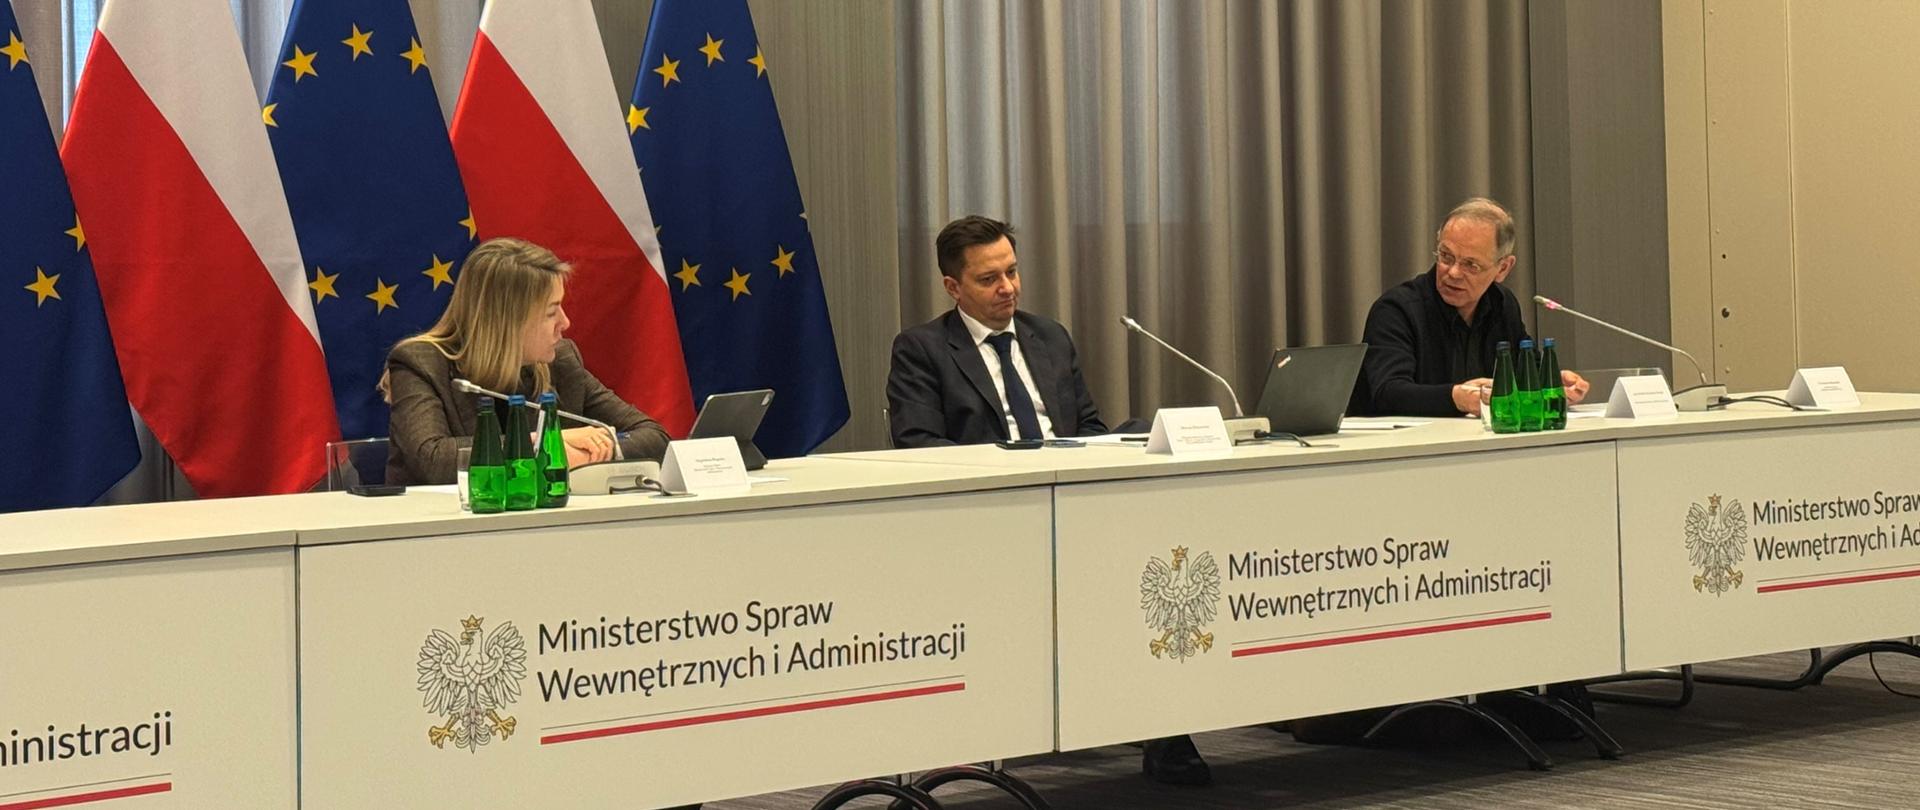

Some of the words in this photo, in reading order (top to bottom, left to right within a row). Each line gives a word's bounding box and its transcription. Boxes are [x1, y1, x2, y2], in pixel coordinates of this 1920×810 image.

[1752, 497, 1871, 525] Ministerstwo
[1228, 545, 1378, 580] Ministerstwo
[1382, 538, 1450, 569] Spraw
[1753, 526, 1888, 562] Wewnętrznych
[1891, 524, 1896, 548] i
[1228, 577, 1399, 621] Wewnętrznych
[1404, 575, 1409, 602] i
[1414, 560, 1551, 600] Administracji
[539, 611, 739, 655] Ministerstwo
[745, 601, 834, 637] Spraw
[536, 646, 765, 702] Wewnętrznych
[773, 643, 779, 675] i
[786, 623, 965, 672] Administracji
[0, 711, 172, 767] inistracji
